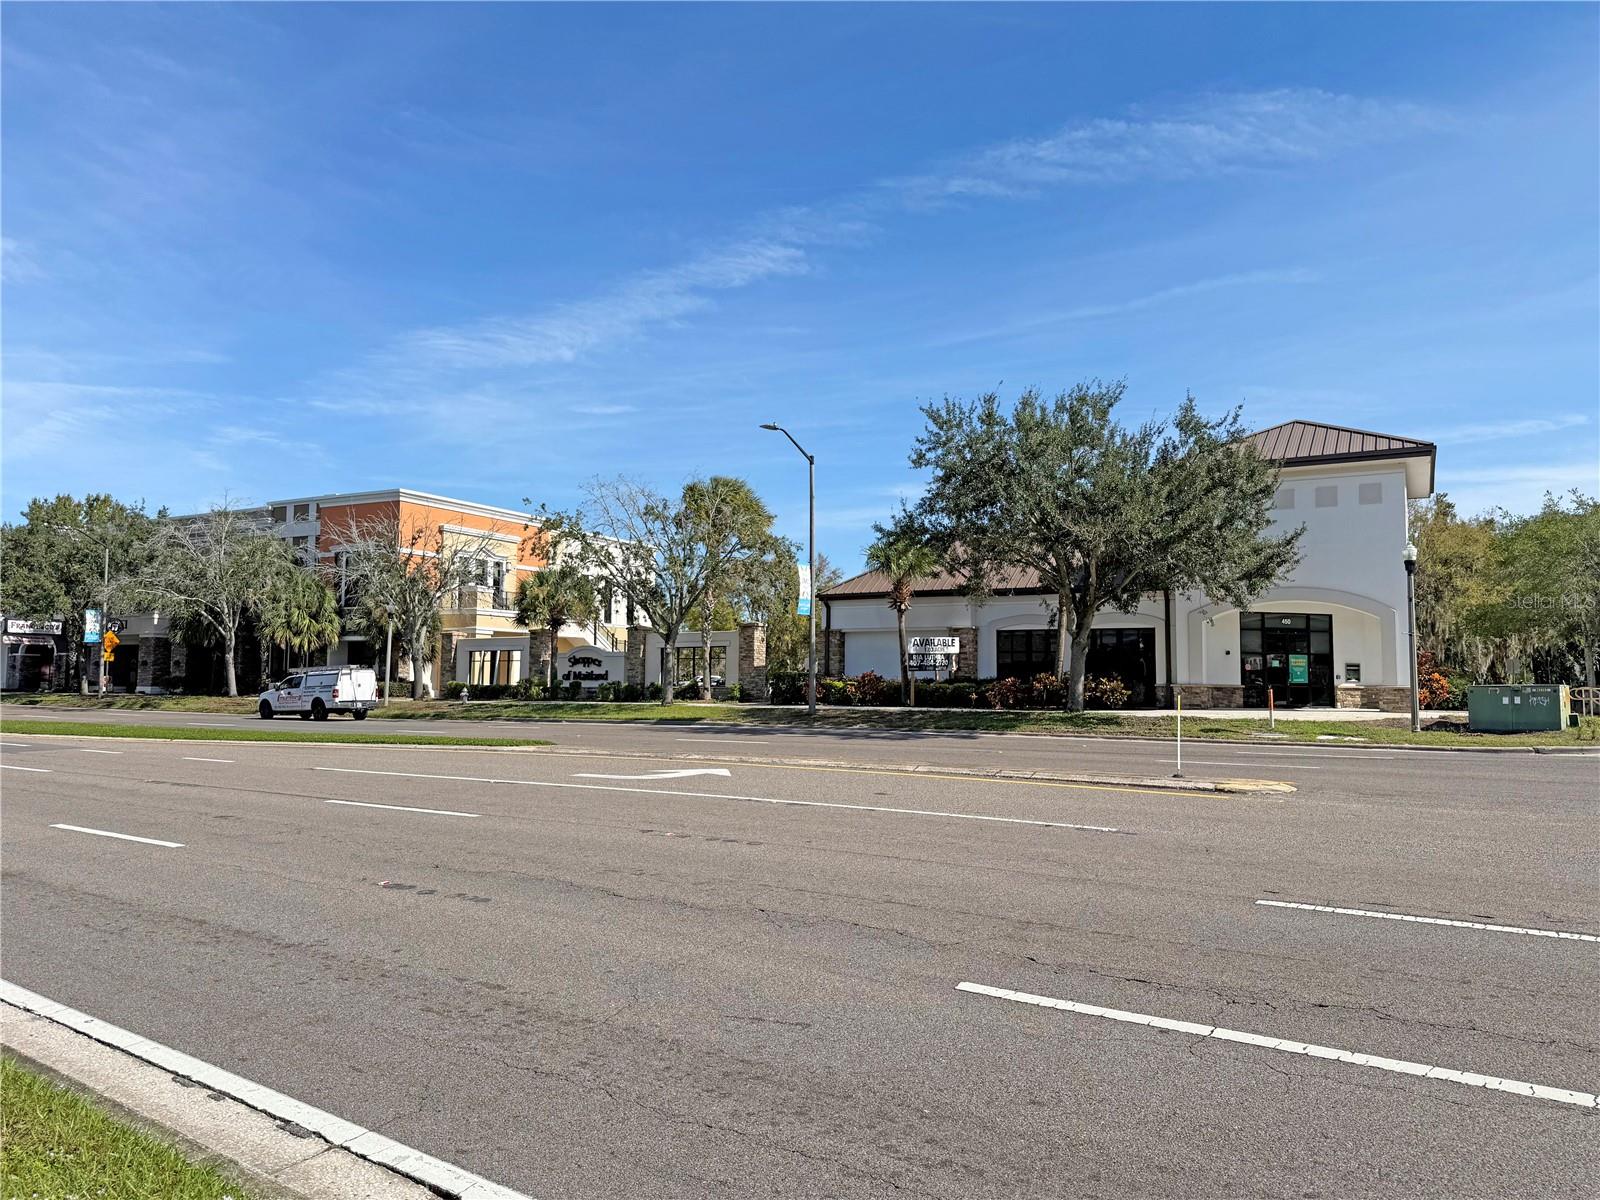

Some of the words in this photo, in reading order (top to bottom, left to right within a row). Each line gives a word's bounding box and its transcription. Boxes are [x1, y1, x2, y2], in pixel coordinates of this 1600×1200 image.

[912, 638, 956, 647] AVAILABLE
[568, 655, 603, 668] Shoppes
[562, 670, 572, 681] of
[572, 670, 609, 681] Maitland
